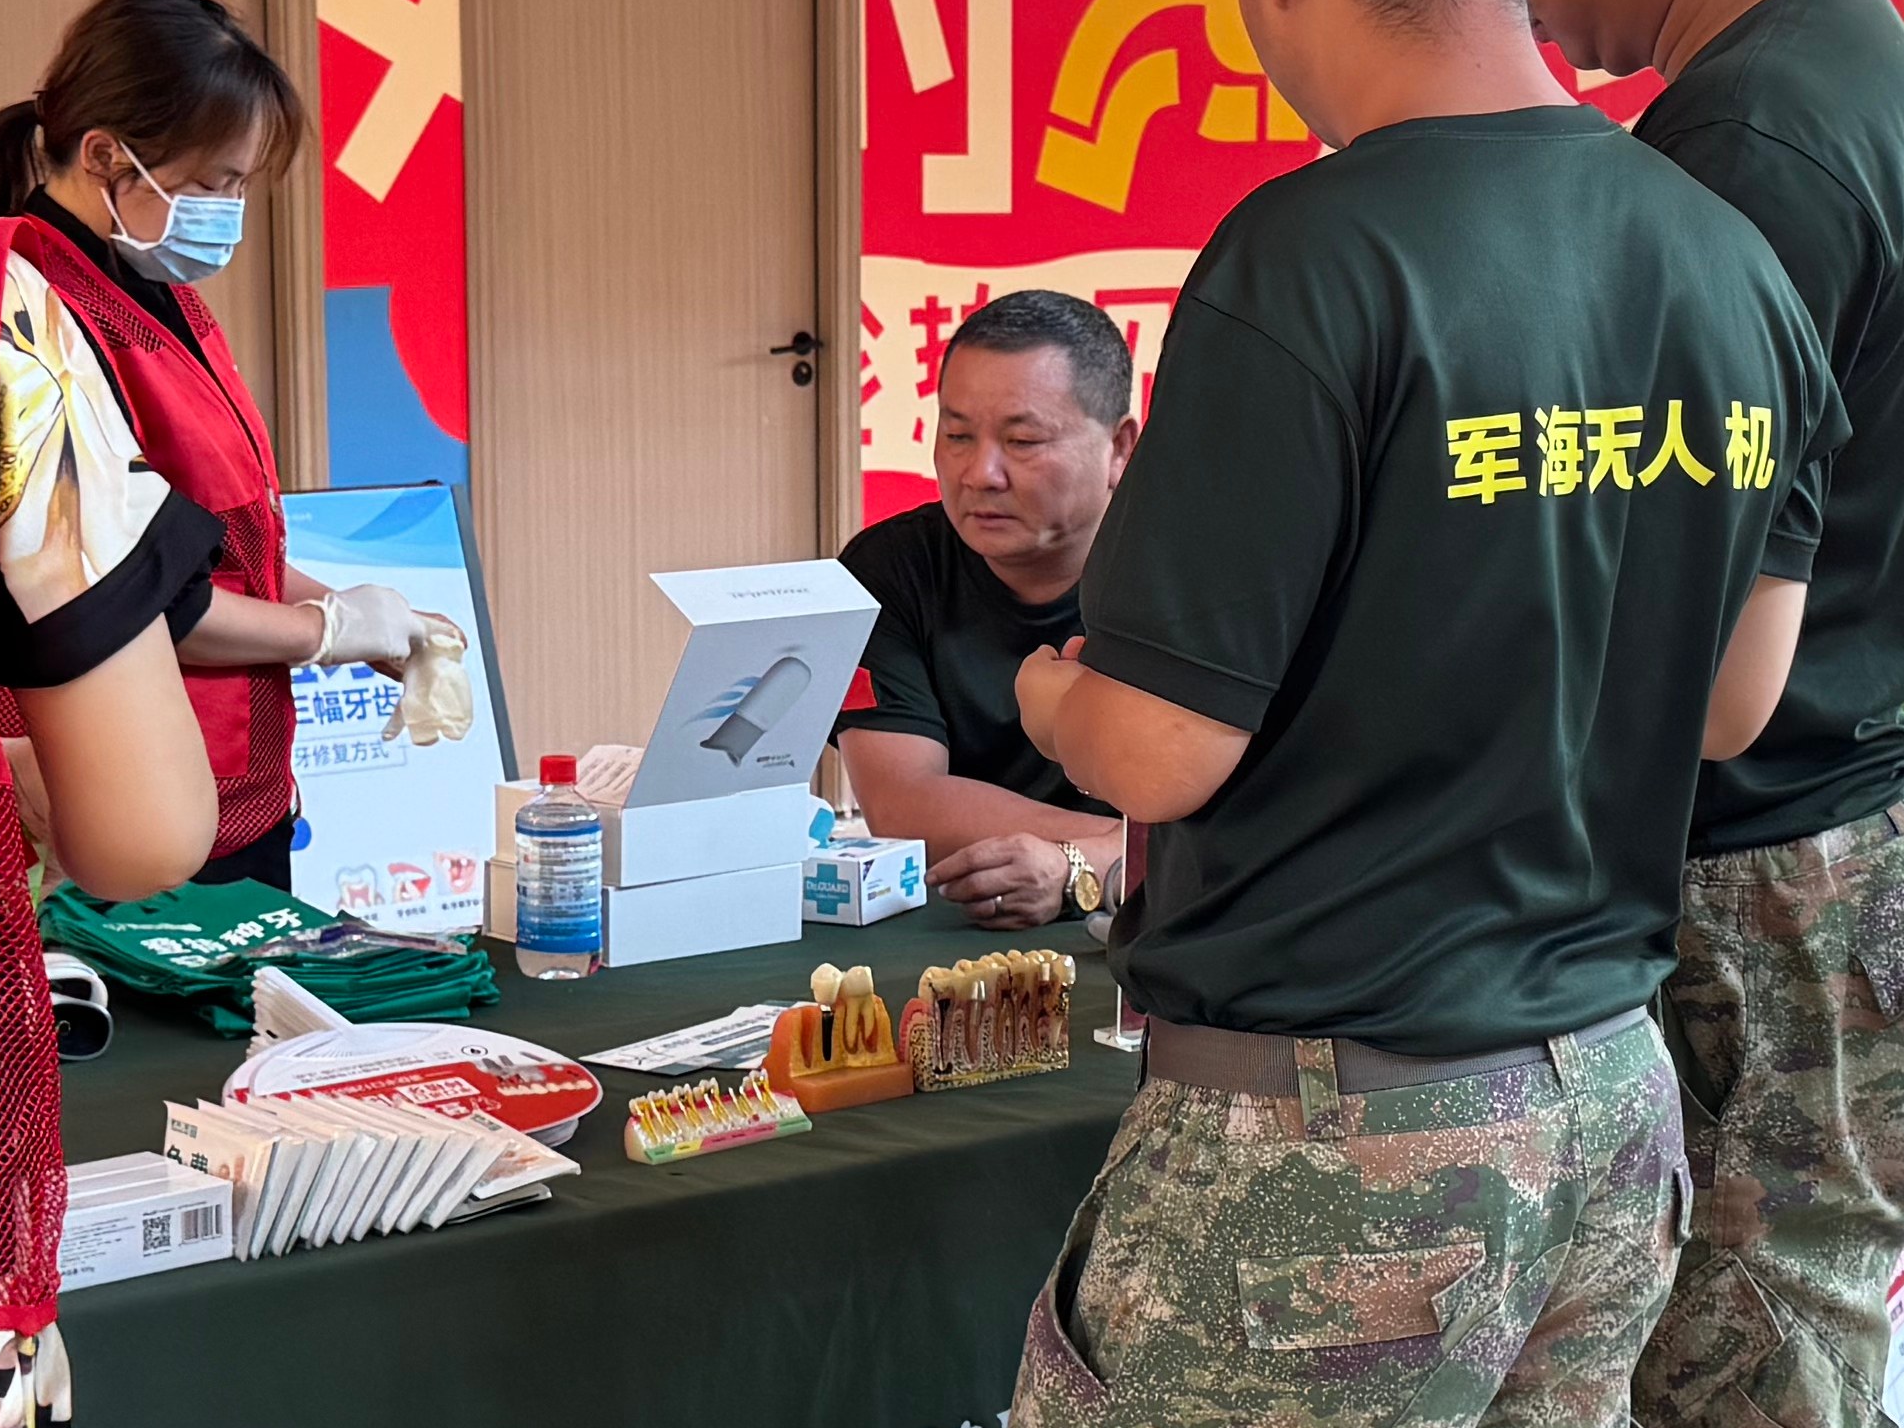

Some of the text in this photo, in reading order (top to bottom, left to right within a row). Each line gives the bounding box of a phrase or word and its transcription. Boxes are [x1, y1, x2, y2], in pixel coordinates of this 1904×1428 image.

[1446, 400, 1775, 504] 军海无人机
